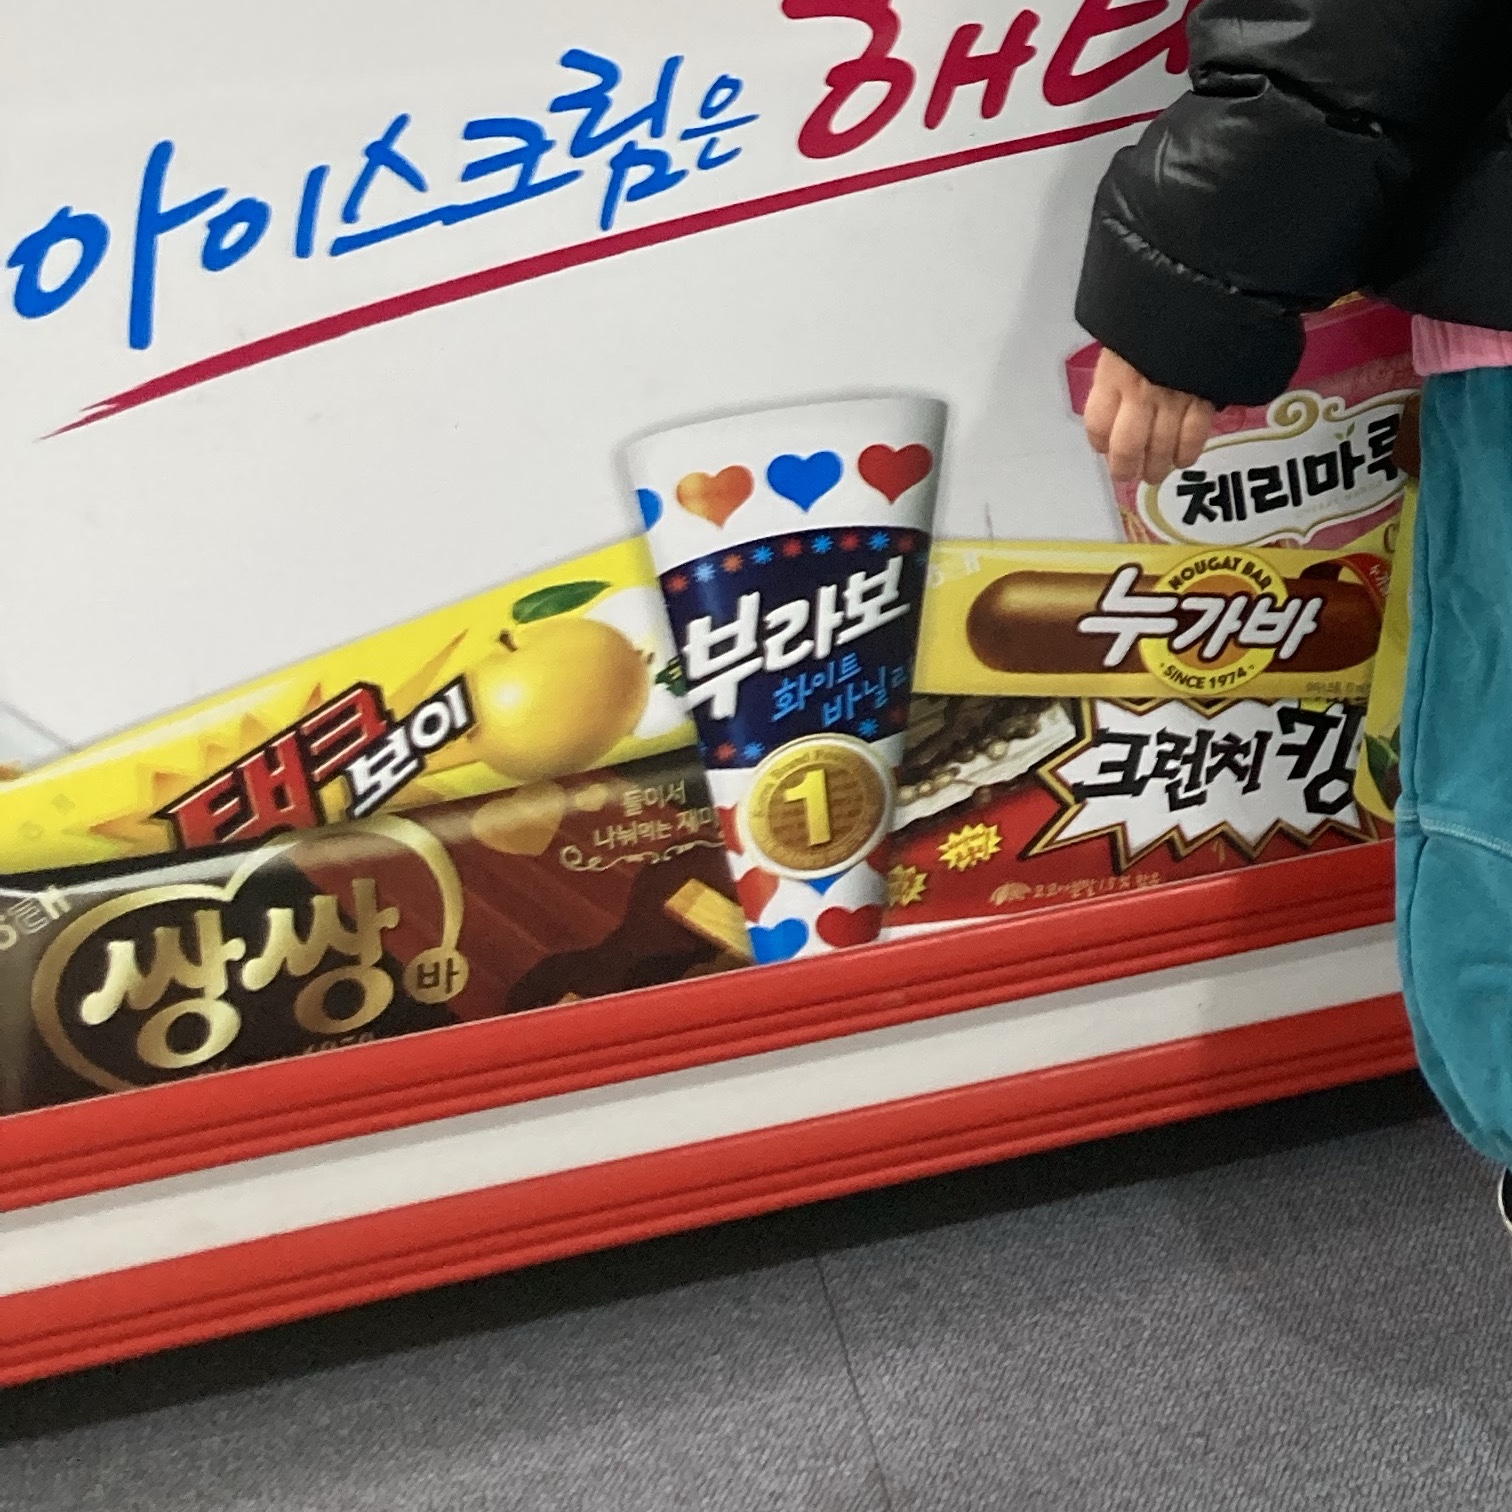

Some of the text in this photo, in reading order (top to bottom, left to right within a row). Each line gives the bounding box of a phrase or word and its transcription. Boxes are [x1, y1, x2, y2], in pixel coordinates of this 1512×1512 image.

[6, 48, 760, 350] 아이스크림은
[1077, 563, 1324, 669] 누가바
[1166, 554, 1273, 592] NOUGAT BAR
[679, 554, 912, 721] 부라보
[1162, 664, 1248, 690] SINCE 1974
[771, 651, 864, 723] 화이트
[1072, 702, 1370, 818] 크런치킹
[783, 767, 831, 846] 1
